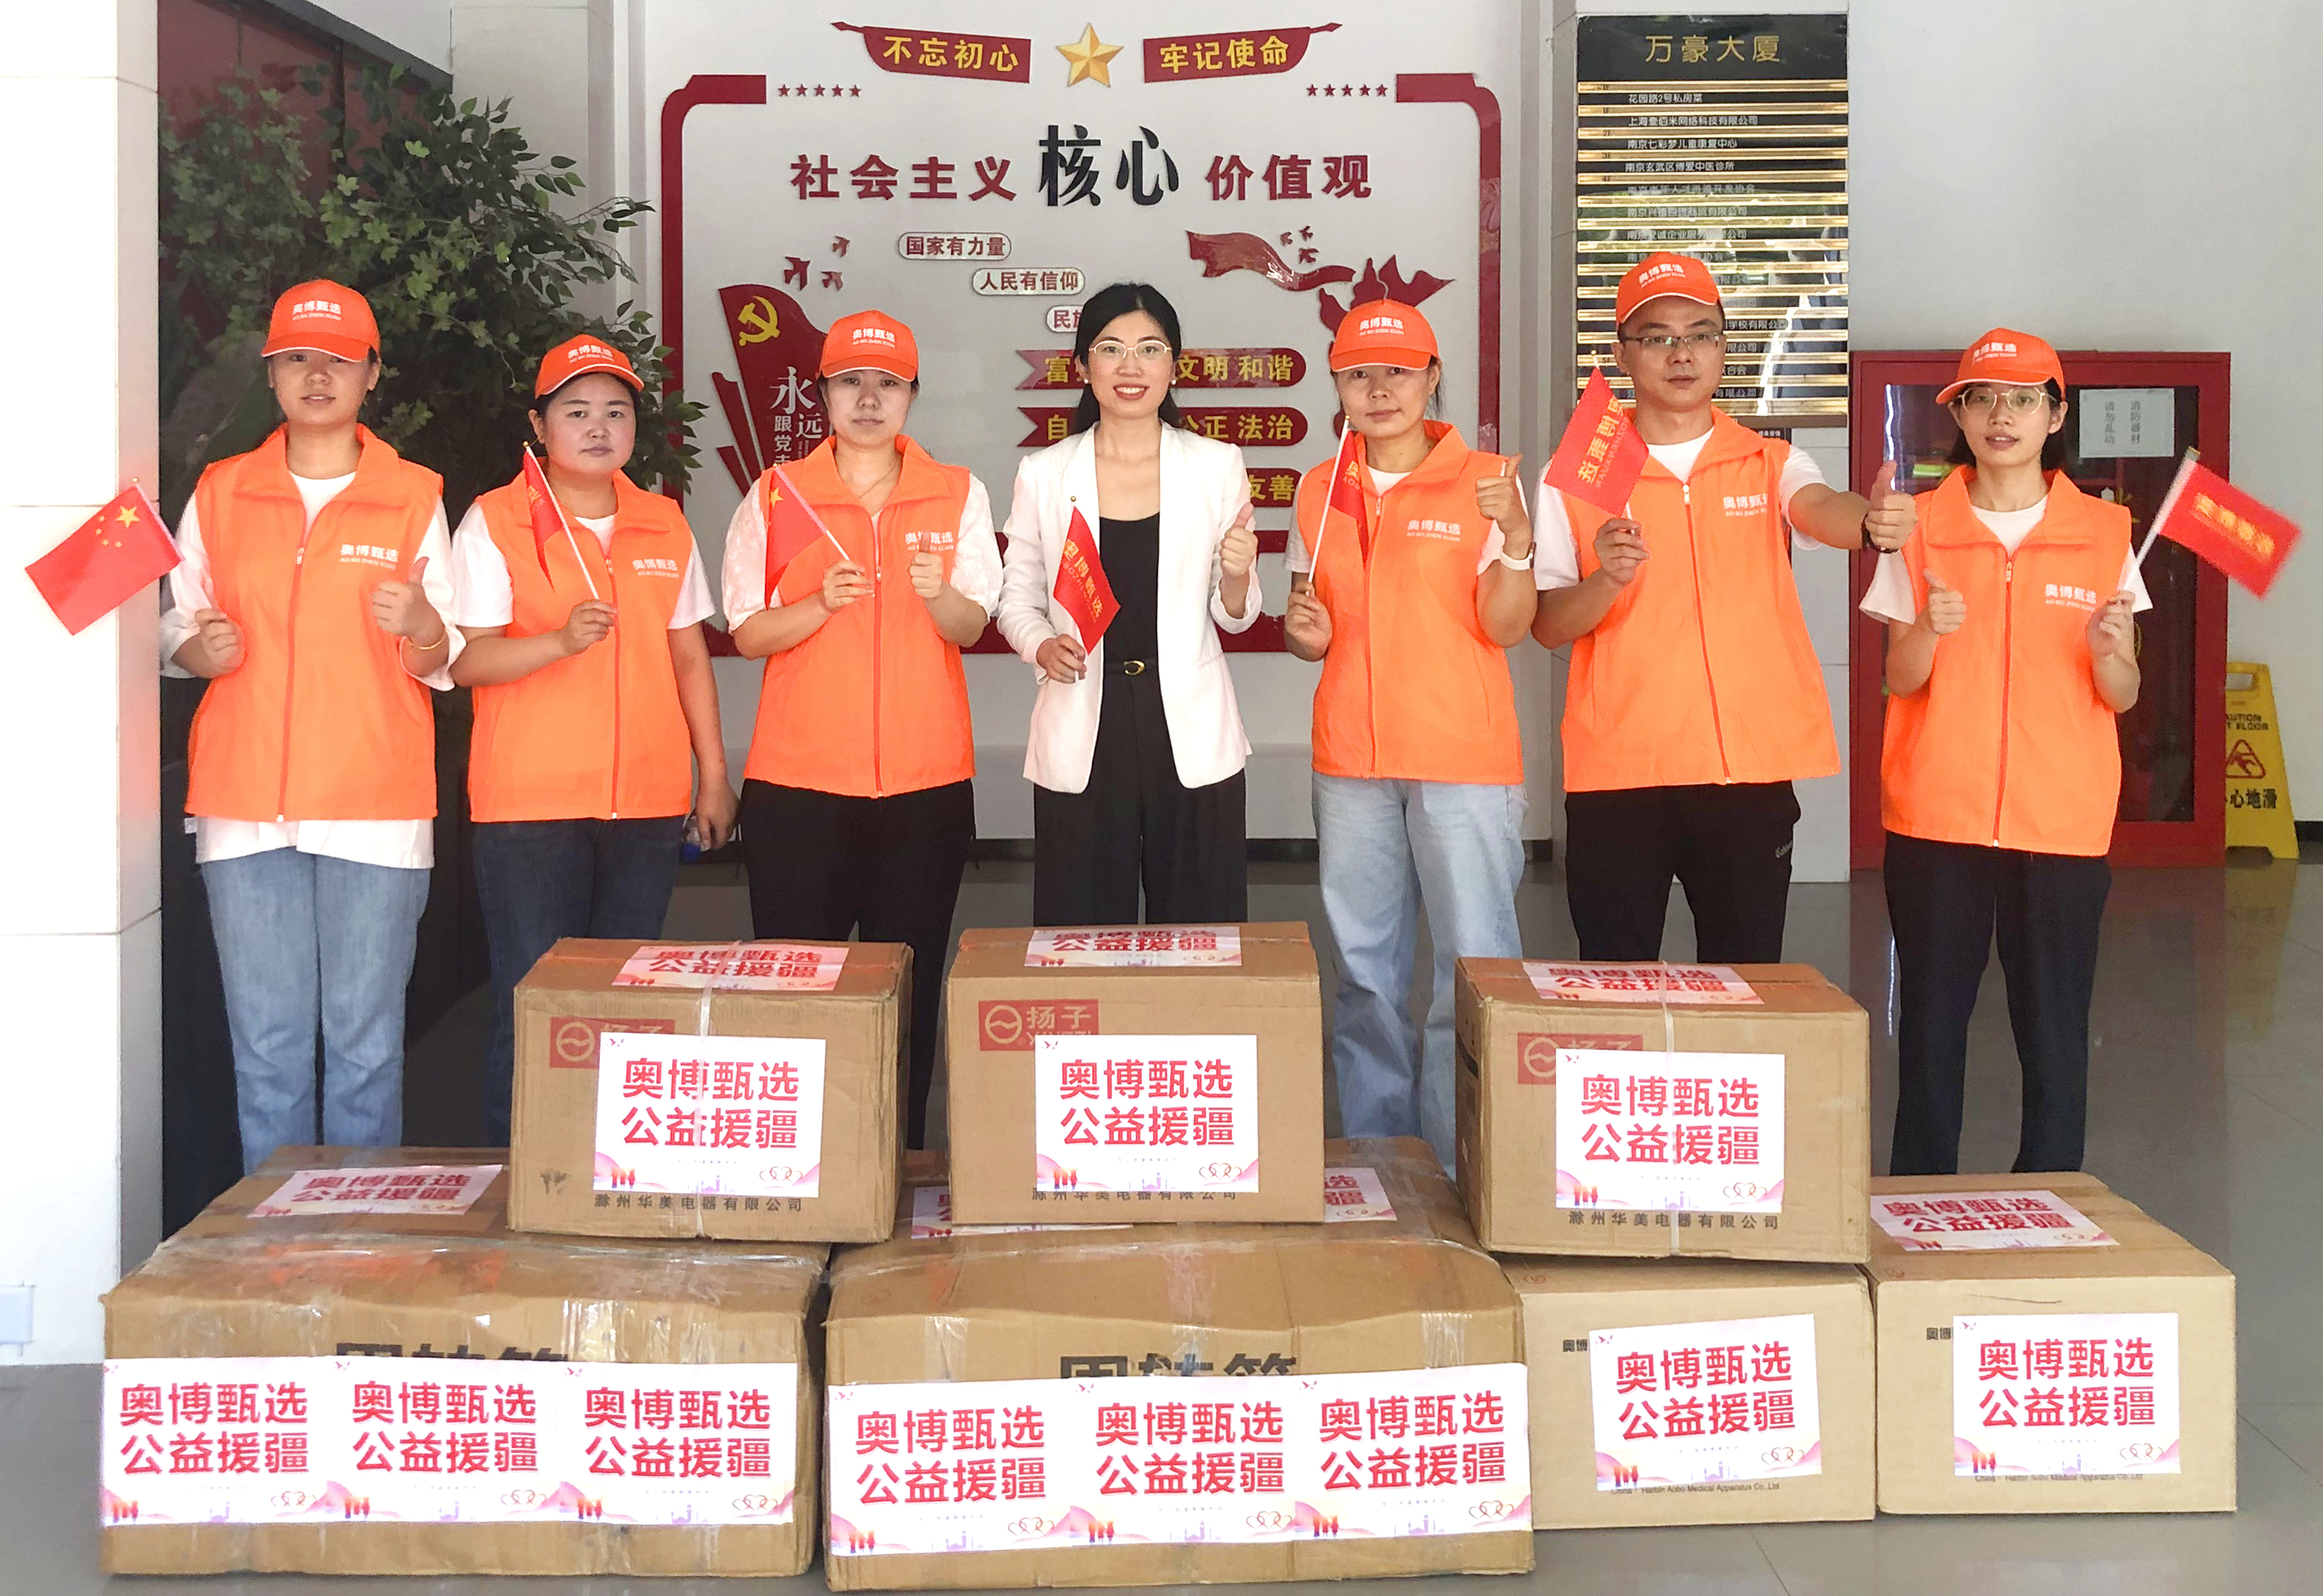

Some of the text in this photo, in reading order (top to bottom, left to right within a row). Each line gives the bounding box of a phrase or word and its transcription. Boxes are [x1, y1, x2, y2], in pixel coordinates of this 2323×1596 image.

[883, 35, 1019, 72] 不忘初心
[1159, 35, 1290, 74] 牢记使命
[1645, 34, 1783, 63] 万豪大厦
[1628, 94, 1704, 104] 花园路2号私房菜
[1627, 139, 1738, 150] 南京七彩梦儿童康复中心
[790, 124, 1372, 207] 社会主义 核心 价值观
[1625, 162, 1735, 172] 南京玄武区博爱中医诊所
[906, 236, 1006, 256] 国家有力量
[979, 271, 1079, 290] 人民有信仰
[1639, 264, 1684, 285] 奥博甄选
[293, 300, 342, 315] 奥博甄选
[853, 327, 895, 343] 奥博甄选
[1359, 316, 1404, 331] 奥博甄选
[1726, 320, 1788, 330] 学校有限公司
[568, 345, 614, 360] 奥博甄选
[1178, 355, 1294, 381] 文明 和谐
[1237, 414, 1294, 440] 法治
[1407, 520, 1461, 536] 奥博甄选
[340, 543, 399, 563] 奥博甄选
[2045, 583, 2097, 605] 奥博甄选
[2226, 714, 2261, 722] AUTION
[2226, 789, 2277, 809] 心地滑
[656, 950, 822, 963] 奥博甄选
[1052, 937, 1218, 952] 公益援疆
[649, 959, 821, 978] 公益援疆
[1548, 967, 1718, 980] 奥博甄选
[1555, 976, 1729, 992] 公益援疆
[1026, 1006, 1091, 1029] 扬子
[623, 1058, 799, 1102] 奥博甄选
[1060, 1058, 1233, 1100] 奥博甄选
[1581, 1073, 1759, 1118] 奥博甄选
[622, 1106, 797, 1149] 公益援疆
[1060, 1105, 1234, 1146] 公益援疆
[1581, 1123, 1759, 1165] 公益援疆
[594, 1194, 803, 1212] 滁州华美电器有限公司
[1882, 1197, 2053, 1216] 奥博甄选
[1568, 1211, 1779, 1230] 滁州华美电器有限公司
[1903, 1213, 2075, 1233] 公益援疆
[1616, 1341, 1792, 1395] 奥博甄选
[1979, 1337, 2153, 1381] 奥博甄选
[119, 1381, 308, 1427] 奥博甄选
[353, 1380, 536, 1424] 奥博甄选
[585, 1386, 770, 1430] 奥博甄选
[1618, 1388, 1794, 1441] 公益援疆
[1979, 1386, 2154, 1427] 公益援疆
[1096, 1401, 1283, 1447] 奥博甄选
[1320, 1390, 1504, 1443] 奥博甄选
[855, 1405, 1044, 1456] 奥博甄选
[120, 1431, 308, 1474] 公益援疆
[353, 1431, 537, 1474] 公益援疆
[585, 1436, 770, 1478] 公益援疆
[1096, 1452, 1284, 1496] 公益援疆
[1320, 1442, 1506, 1491] 公益援疆
[857, 1457, 1046, 1505] 公益援疆
[1717, 1484, 1752, 1493] Apparatus
